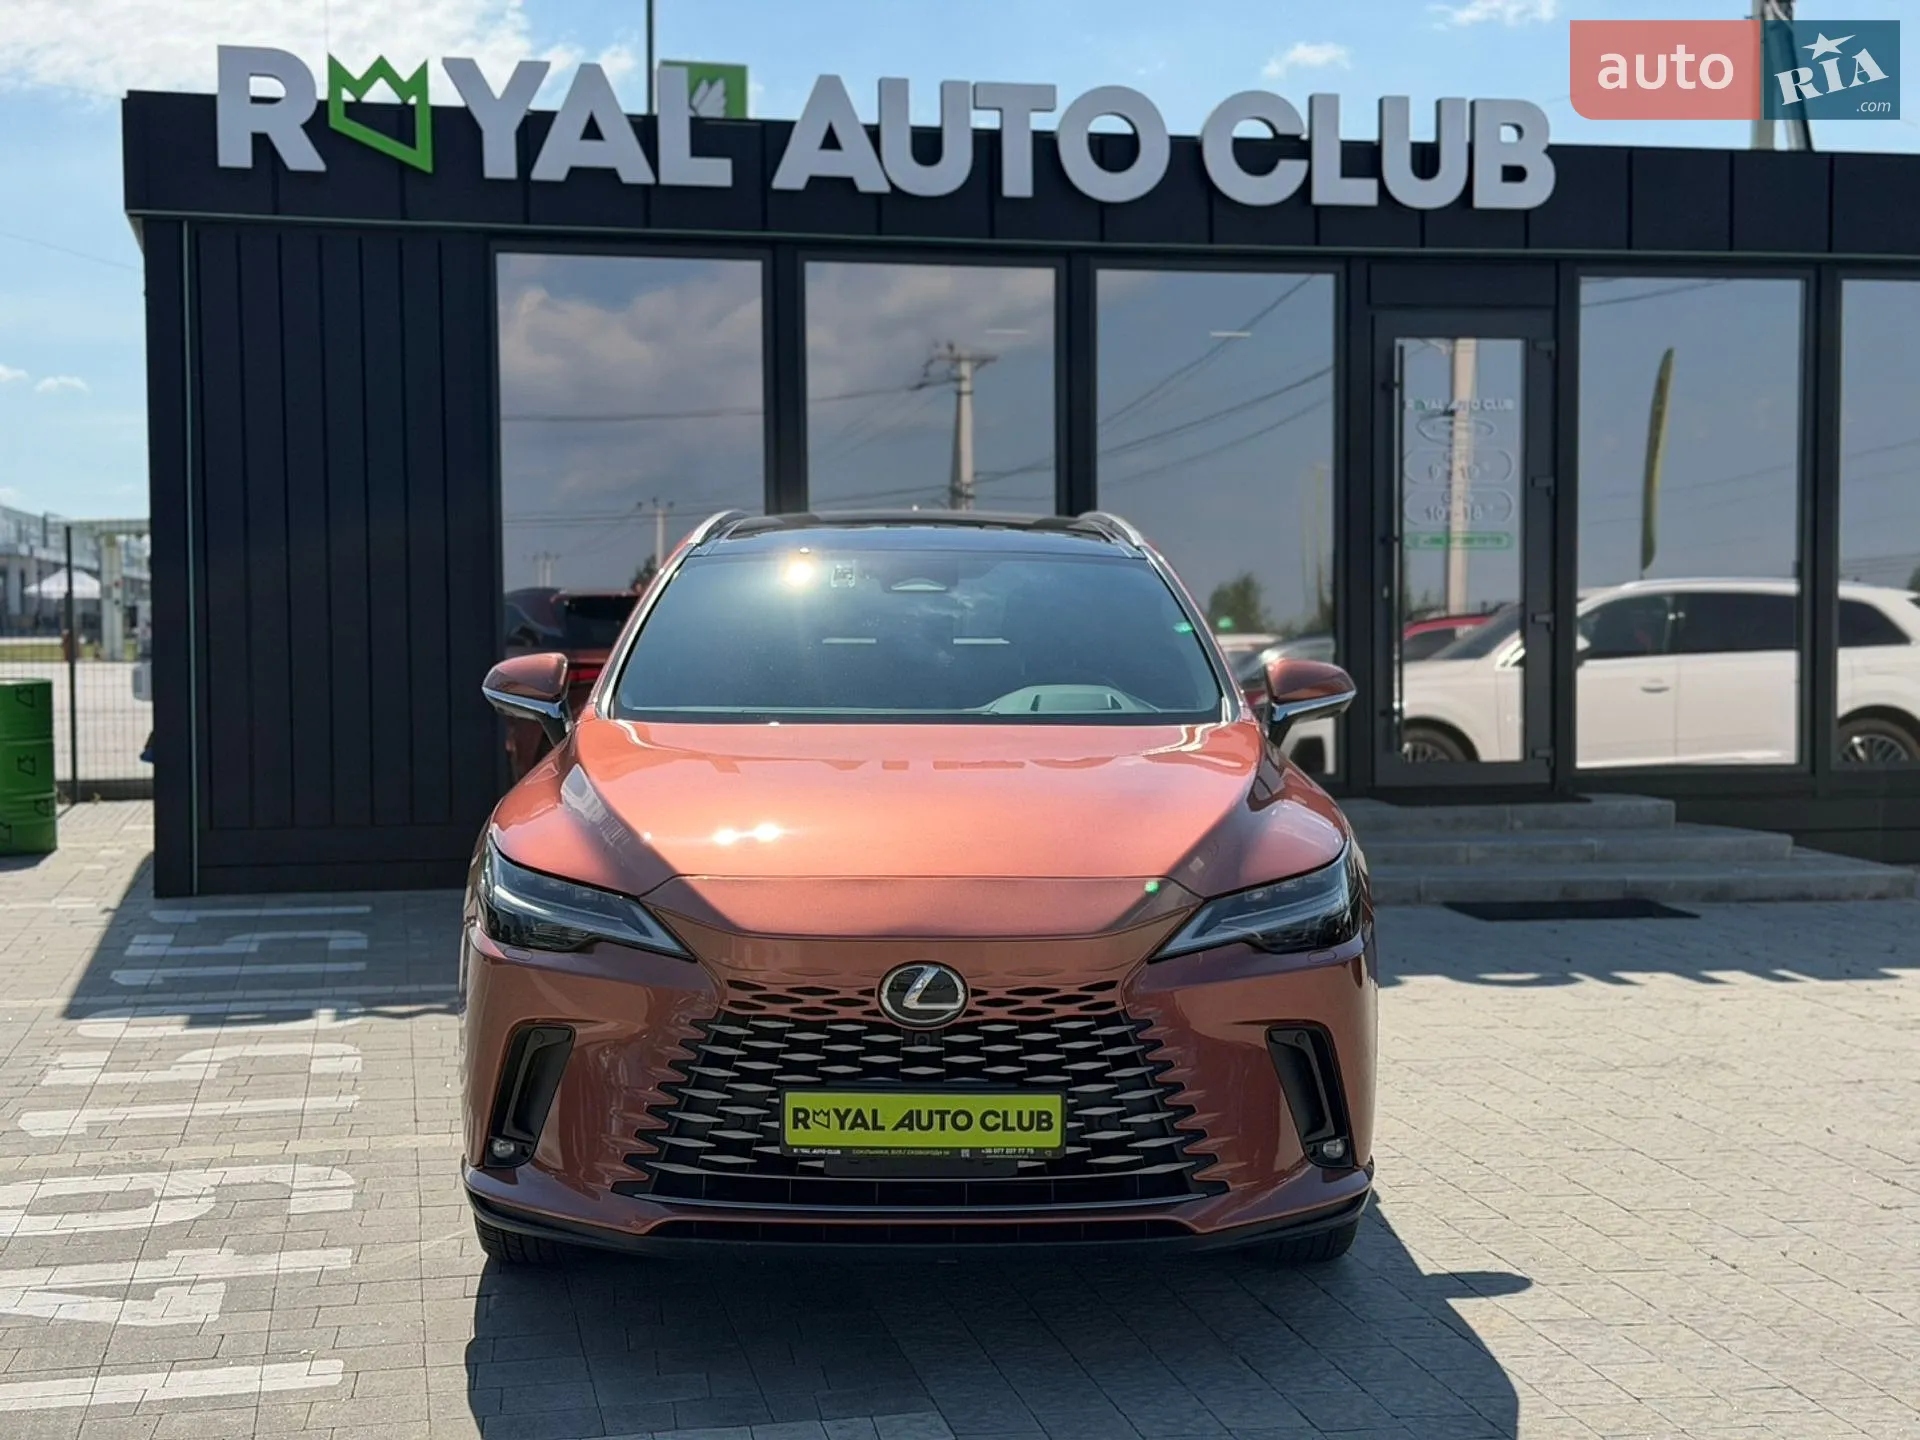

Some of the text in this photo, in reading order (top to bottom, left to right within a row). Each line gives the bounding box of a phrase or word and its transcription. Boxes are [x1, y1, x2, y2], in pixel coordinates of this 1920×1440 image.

[771, 74, 1171, 203] AUTO
[1200, 90, 1556, 210] CLUB
[892, 1109, 974, 1132] AUTO
[980, 1109, 1054, 1132] CLUB
